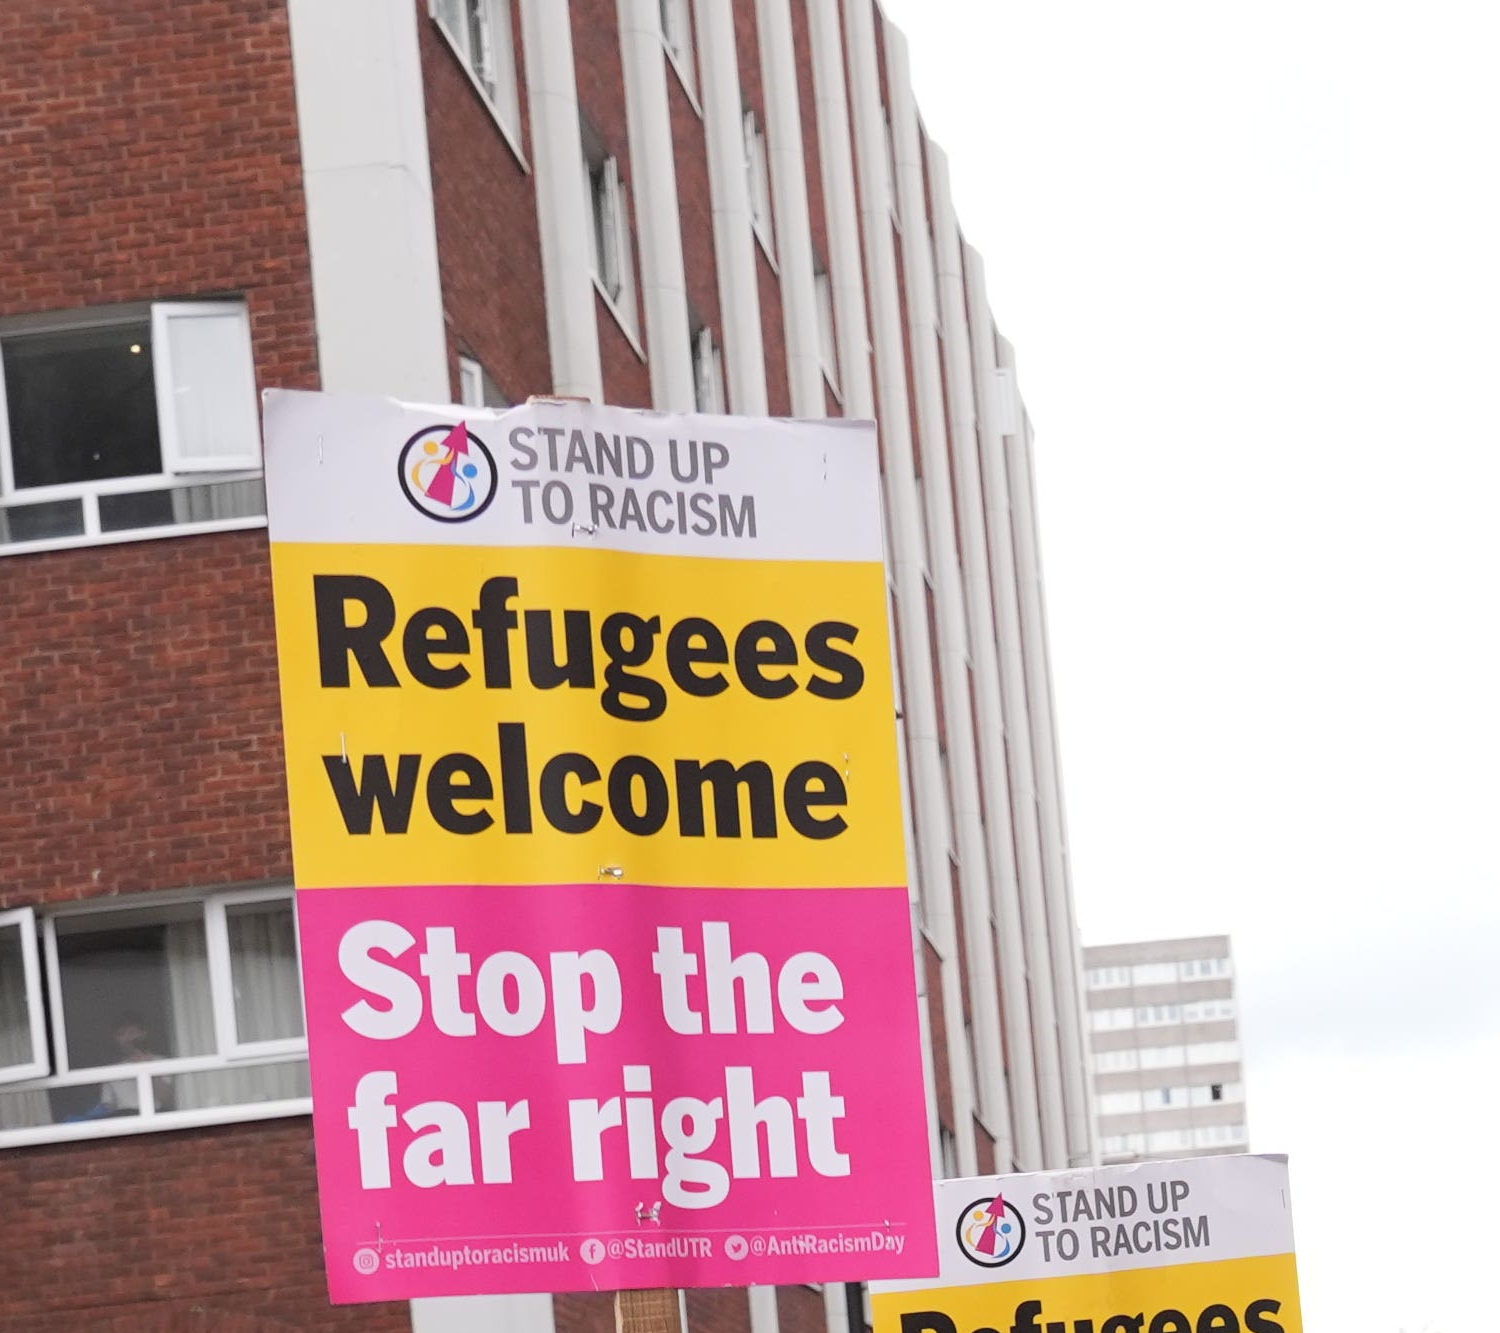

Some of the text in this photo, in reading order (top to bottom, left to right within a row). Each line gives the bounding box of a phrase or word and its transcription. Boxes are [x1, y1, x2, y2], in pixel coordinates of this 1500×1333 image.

[510, 426, 731, 484] STAND UP
[512, 479, 757, 538] TO RACISM
[312, 574, 865, 722] Refugees
[321, 722, 849, 840] welcome
[338, 919, 845, 1065] Stop the
[348, 1065, 851, 1209] far right
[1032, 1180, 1190, 1226] STAND UP
[384, 1232, 905, 1270] standuptoracismuk @StandUTR @AntiRacismDay
[1036, 1215, 1210, 1262] TO RACISM
